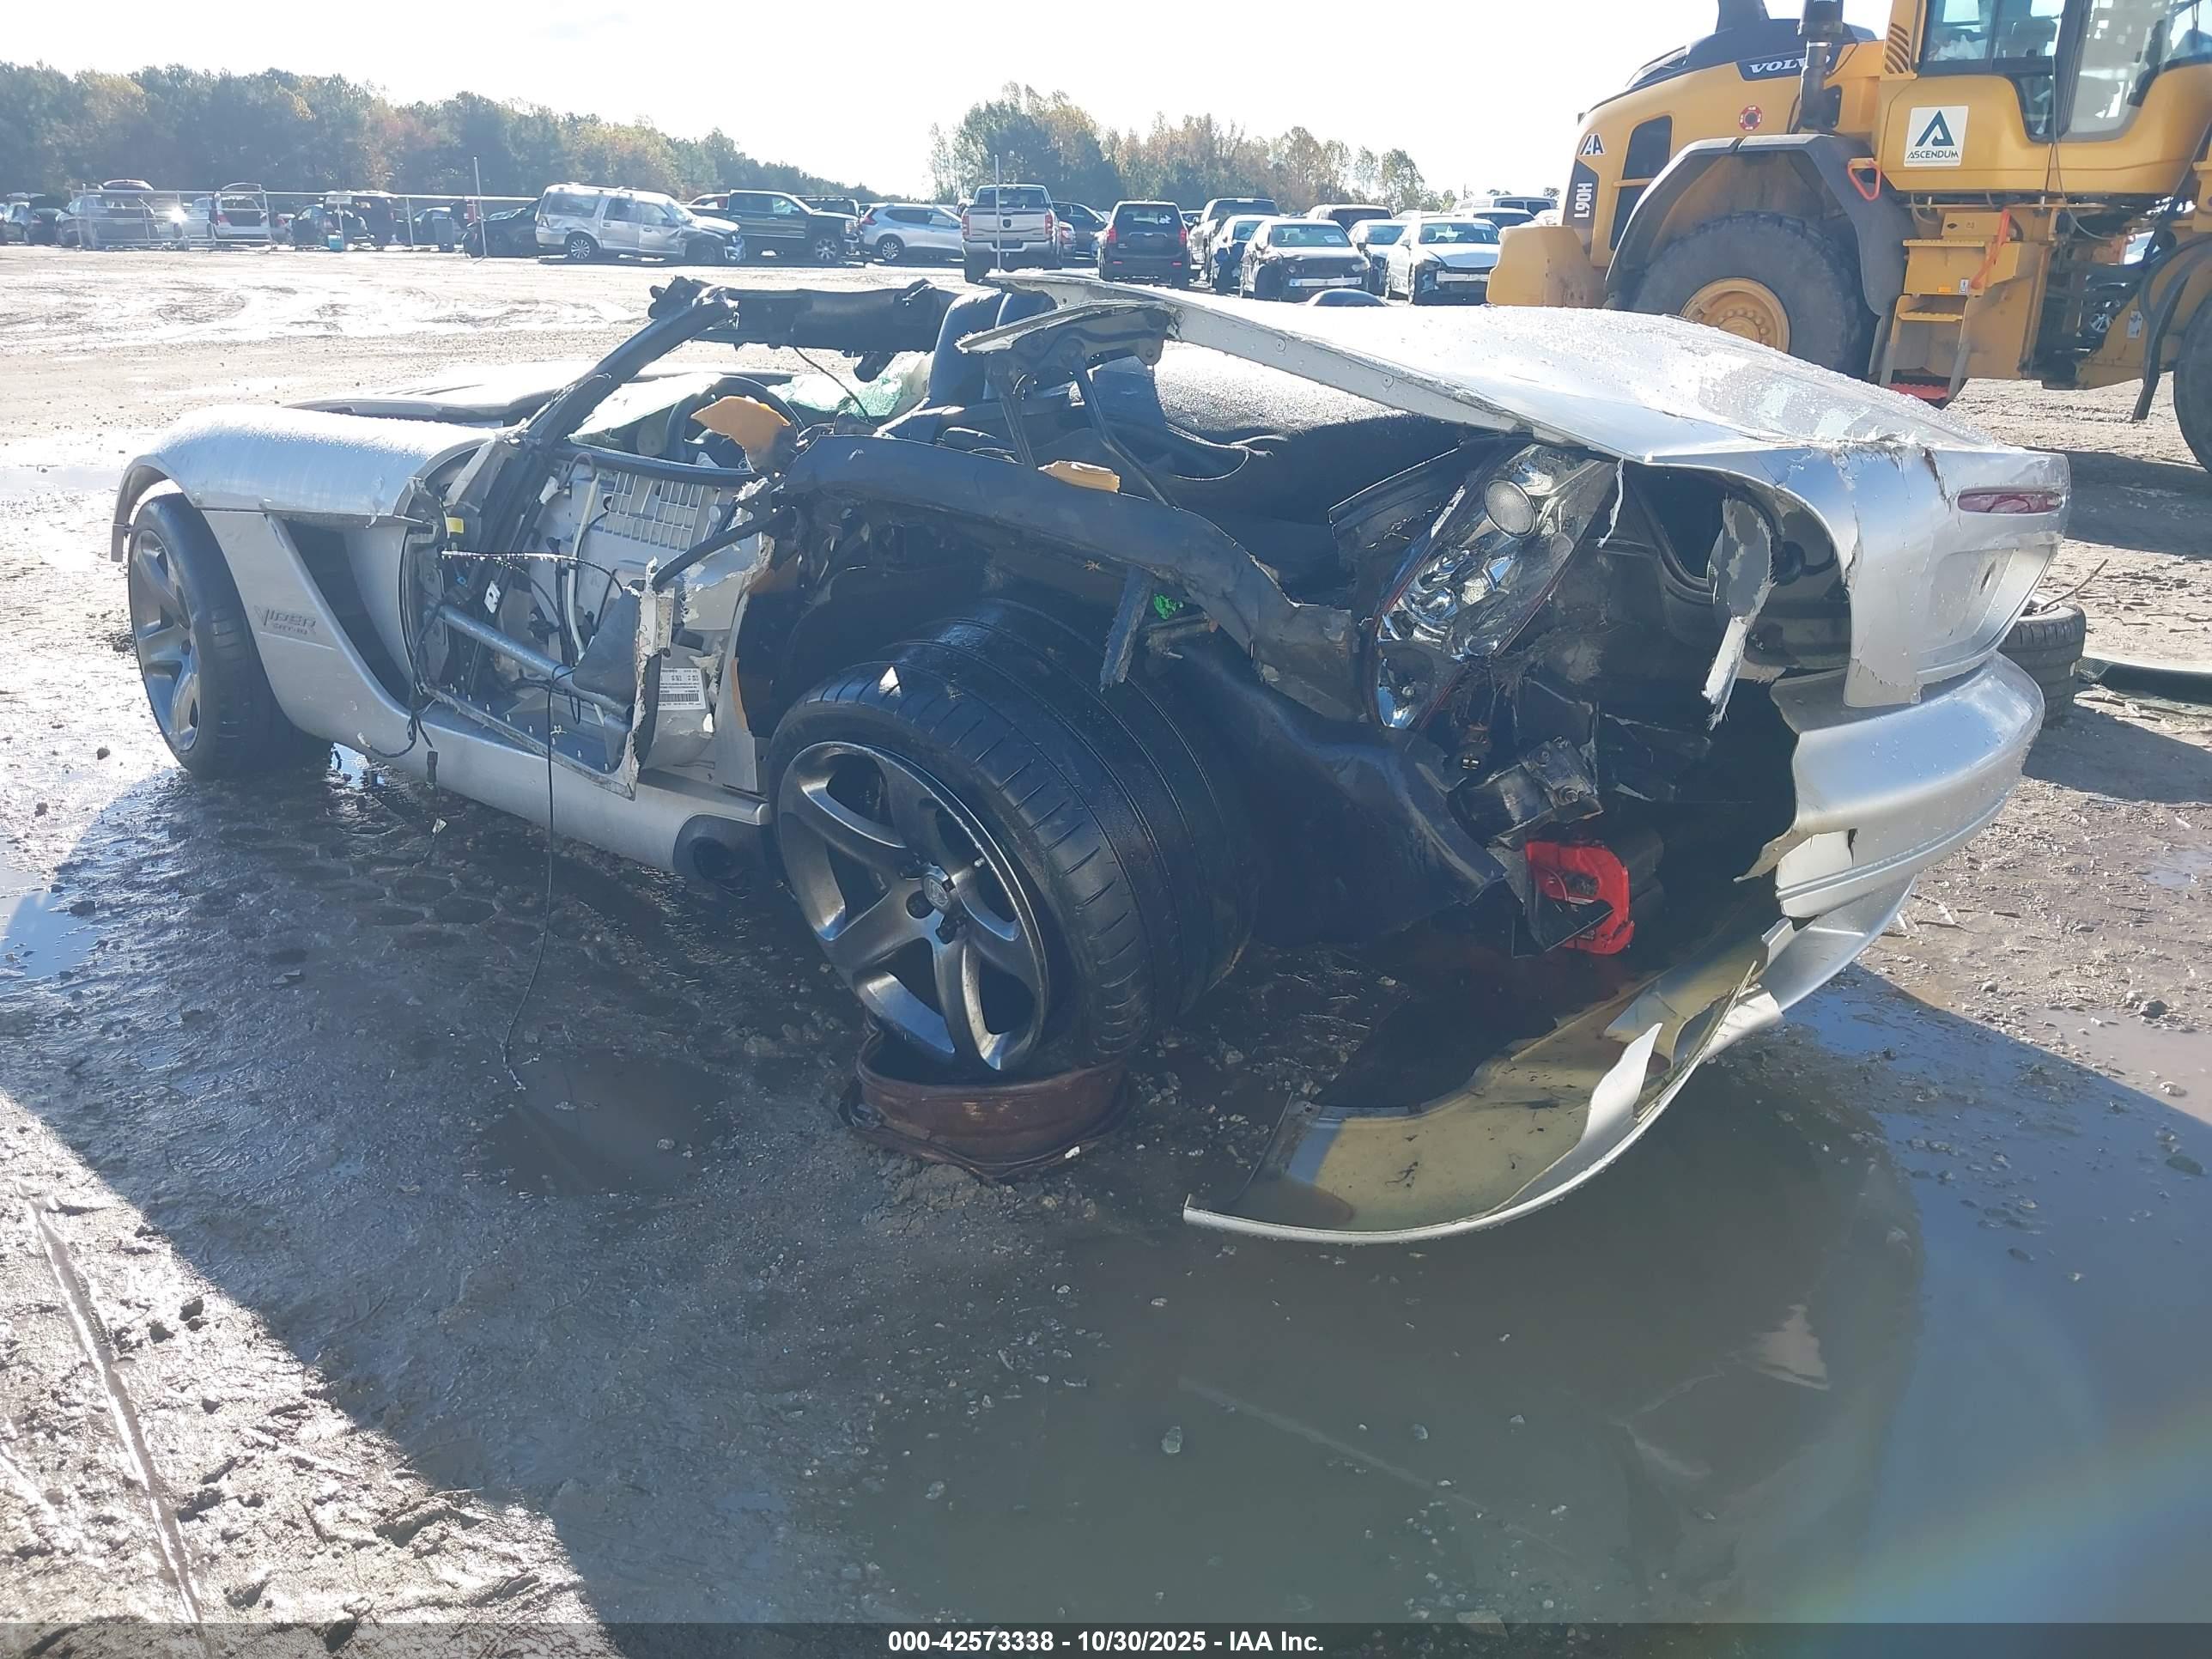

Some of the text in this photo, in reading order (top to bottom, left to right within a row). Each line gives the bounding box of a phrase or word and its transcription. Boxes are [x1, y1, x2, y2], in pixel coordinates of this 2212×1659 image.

[1748, 54, 1831, 74] VOLV
[1906, 149, 1960, 159] ASCENDUM
[1573, 182, 1593, 218] L90H
